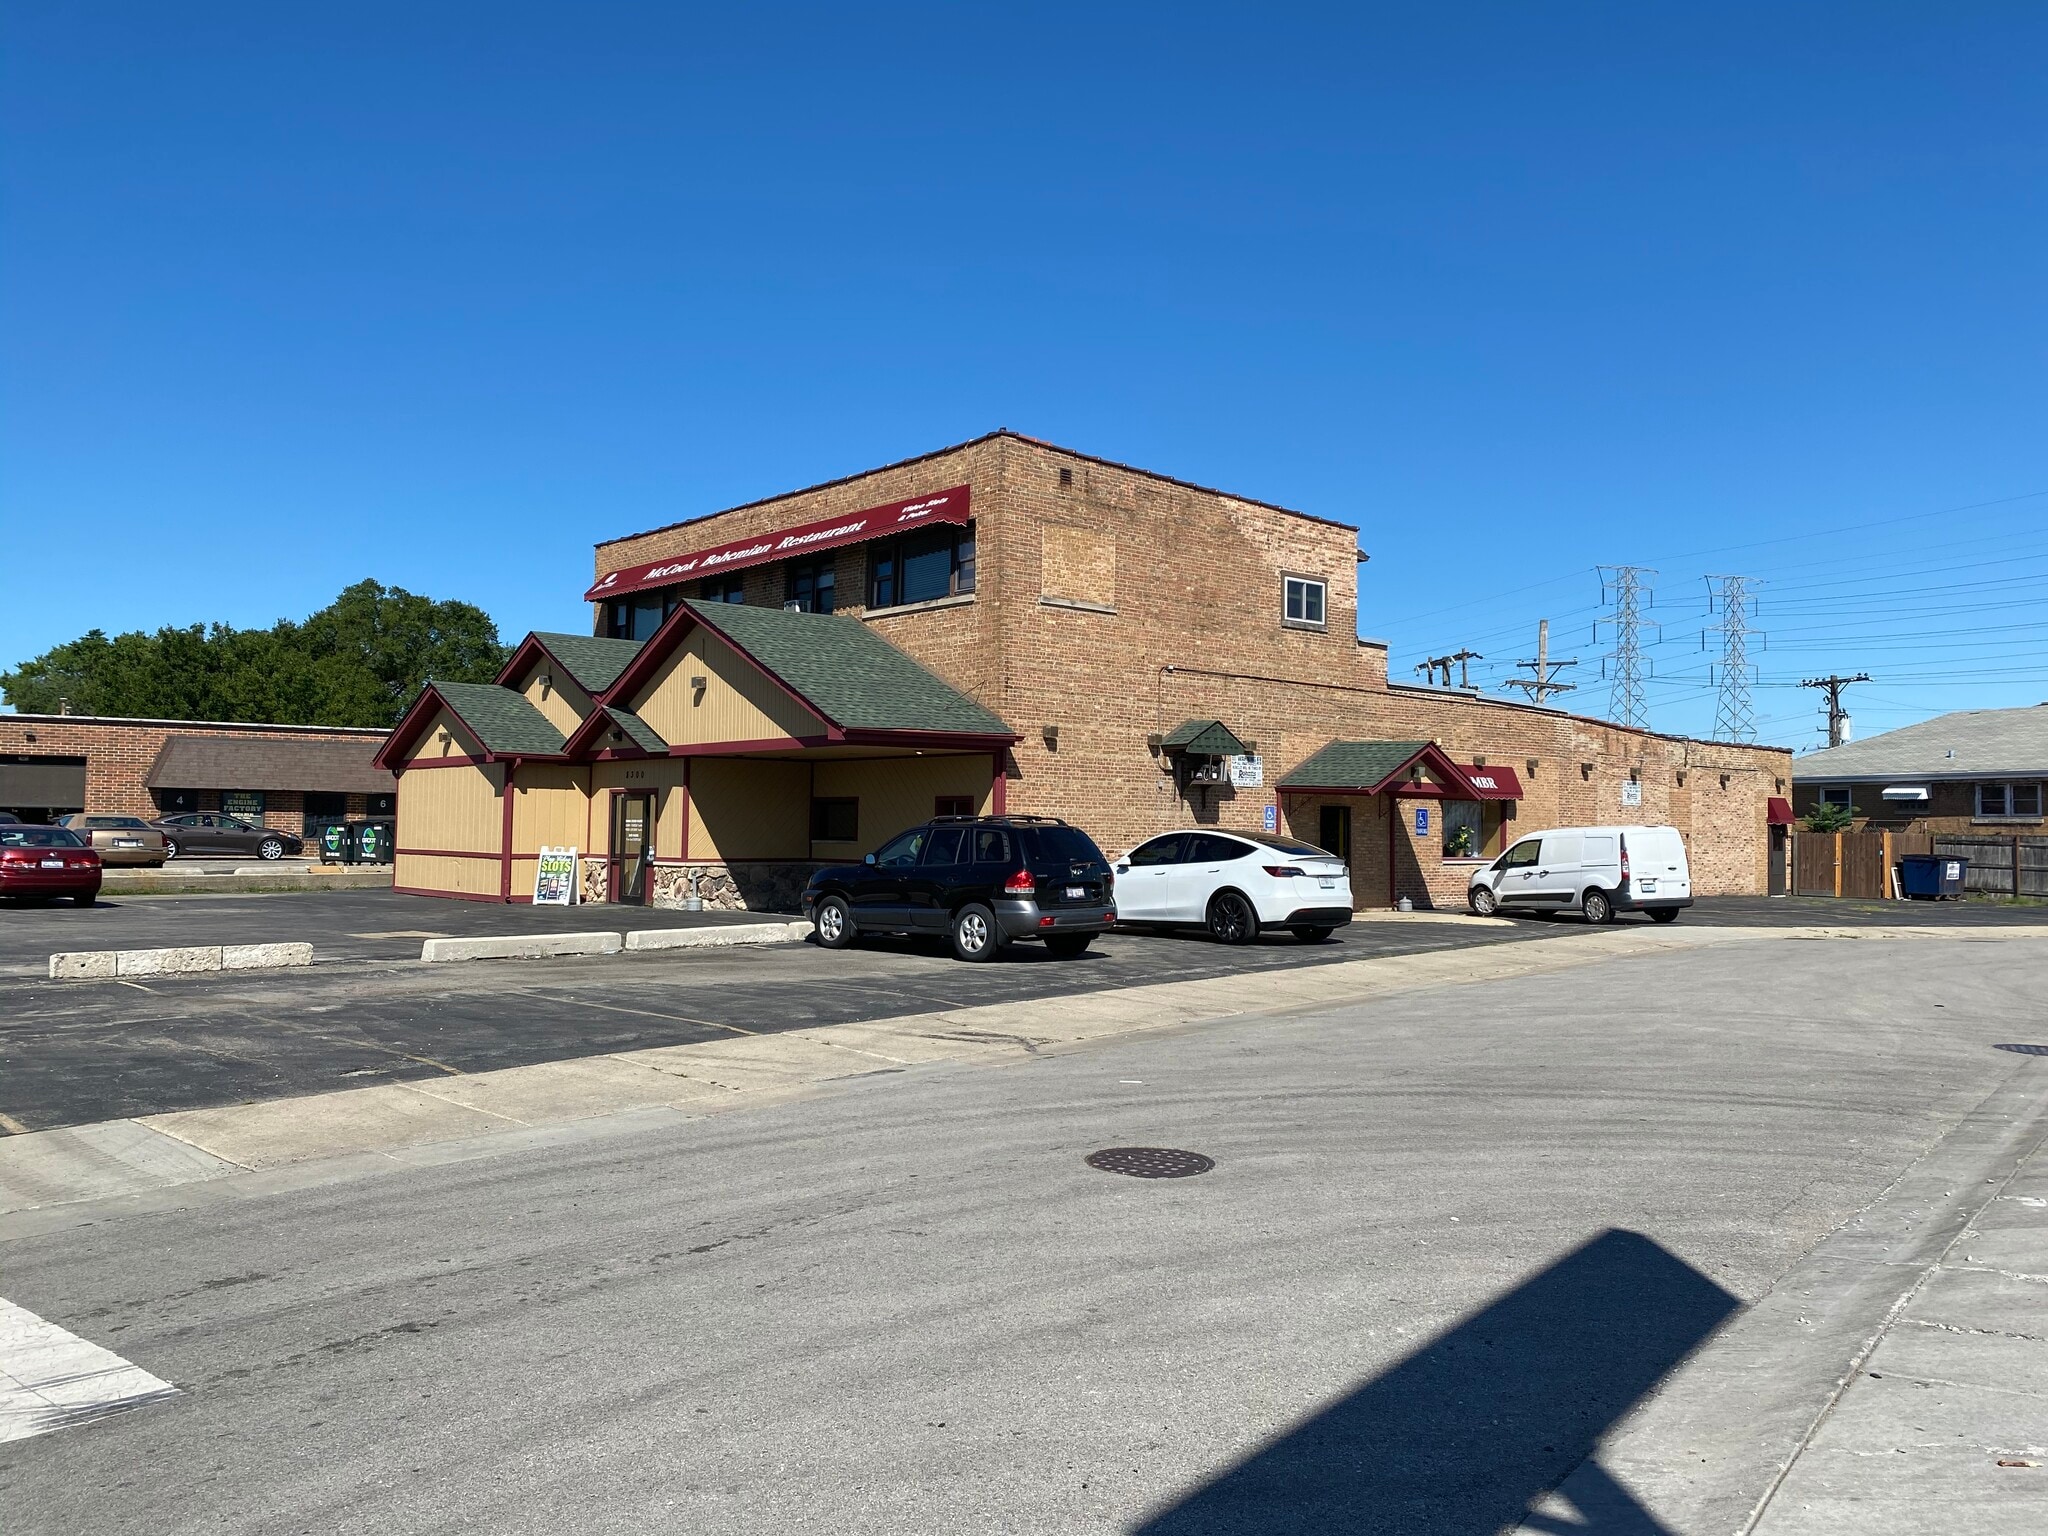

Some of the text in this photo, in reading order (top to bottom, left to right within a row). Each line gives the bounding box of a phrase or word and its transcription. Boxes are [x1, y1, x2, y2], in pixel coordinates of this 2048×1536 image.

[642, 520, 867, 580] McCook Bohemian Restaurant
[176, 795, 184, 805] 4
[380, 800, 387, 808] 6
[541, 860, 572, 873] SLOTS
